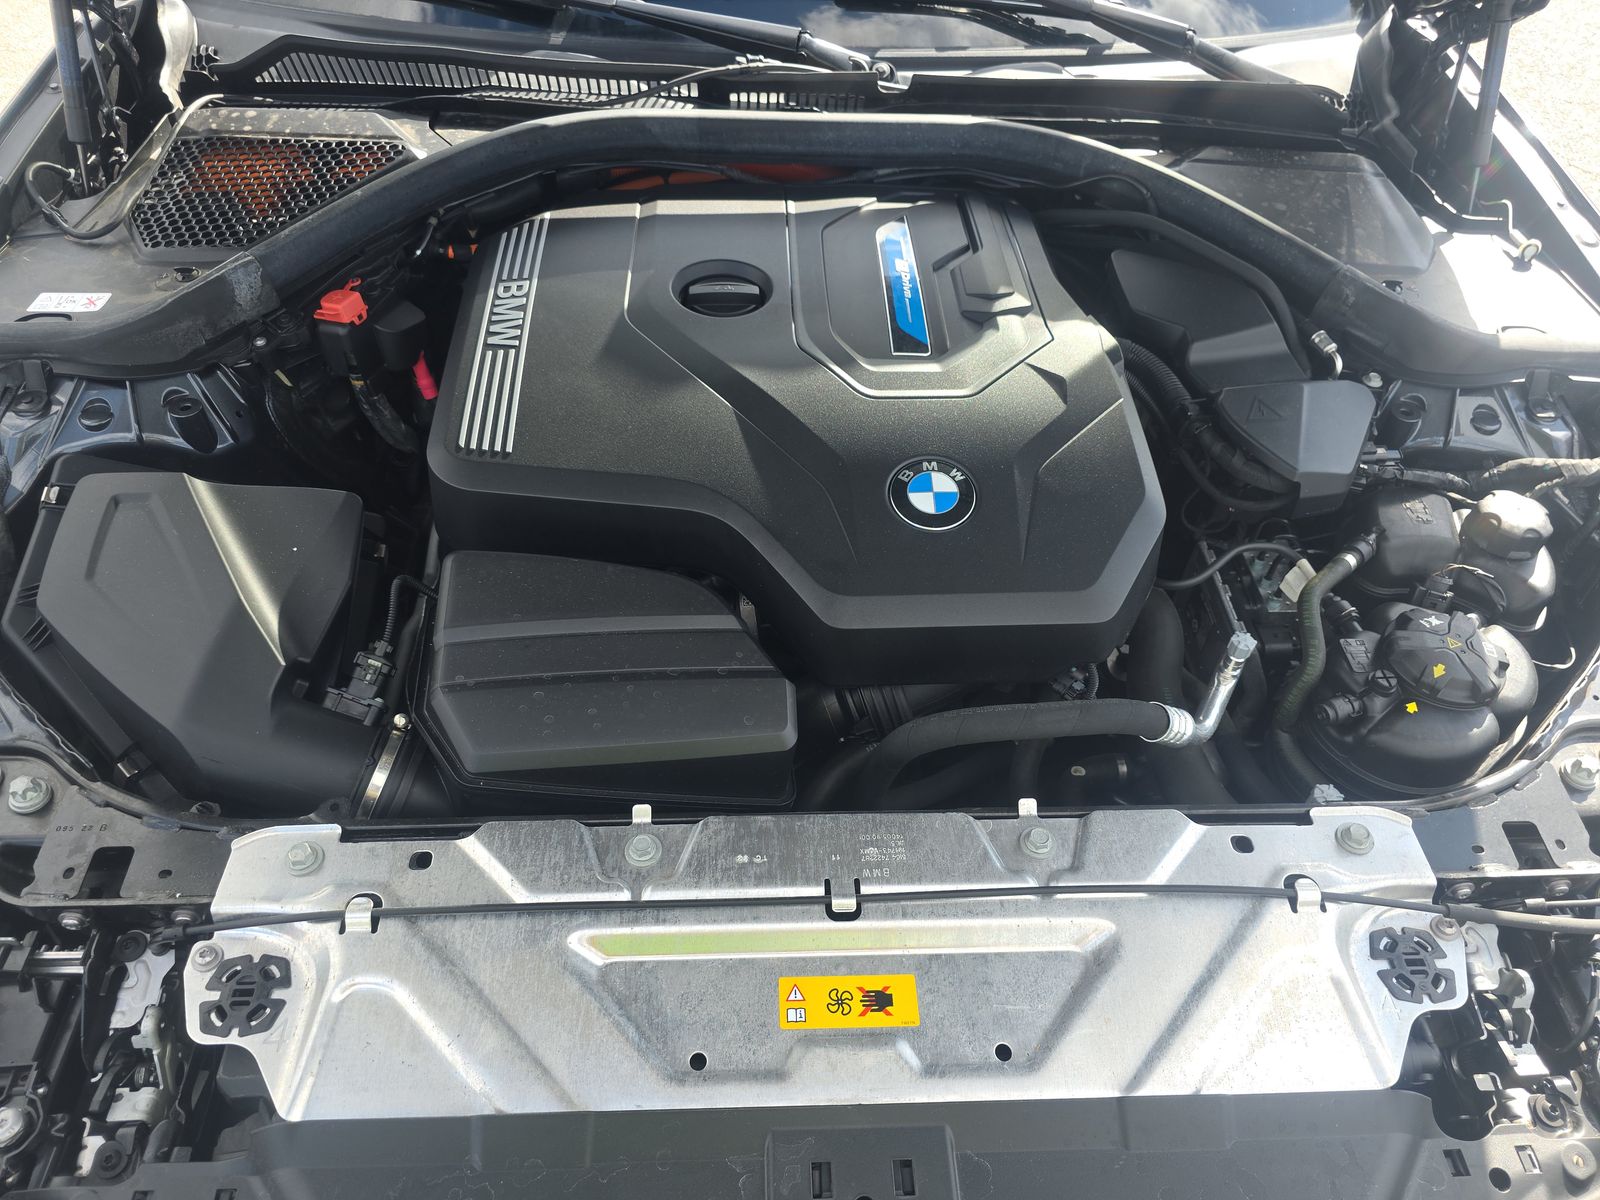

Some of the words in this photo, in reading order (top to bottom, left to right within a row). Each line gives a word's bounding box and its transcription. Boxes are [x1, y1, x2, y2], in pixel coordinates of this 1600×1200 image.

[487, 280, 530, 346] BMW
[898, 461, 966, 483] BMW
[862, 867, 890, 878] BMW
